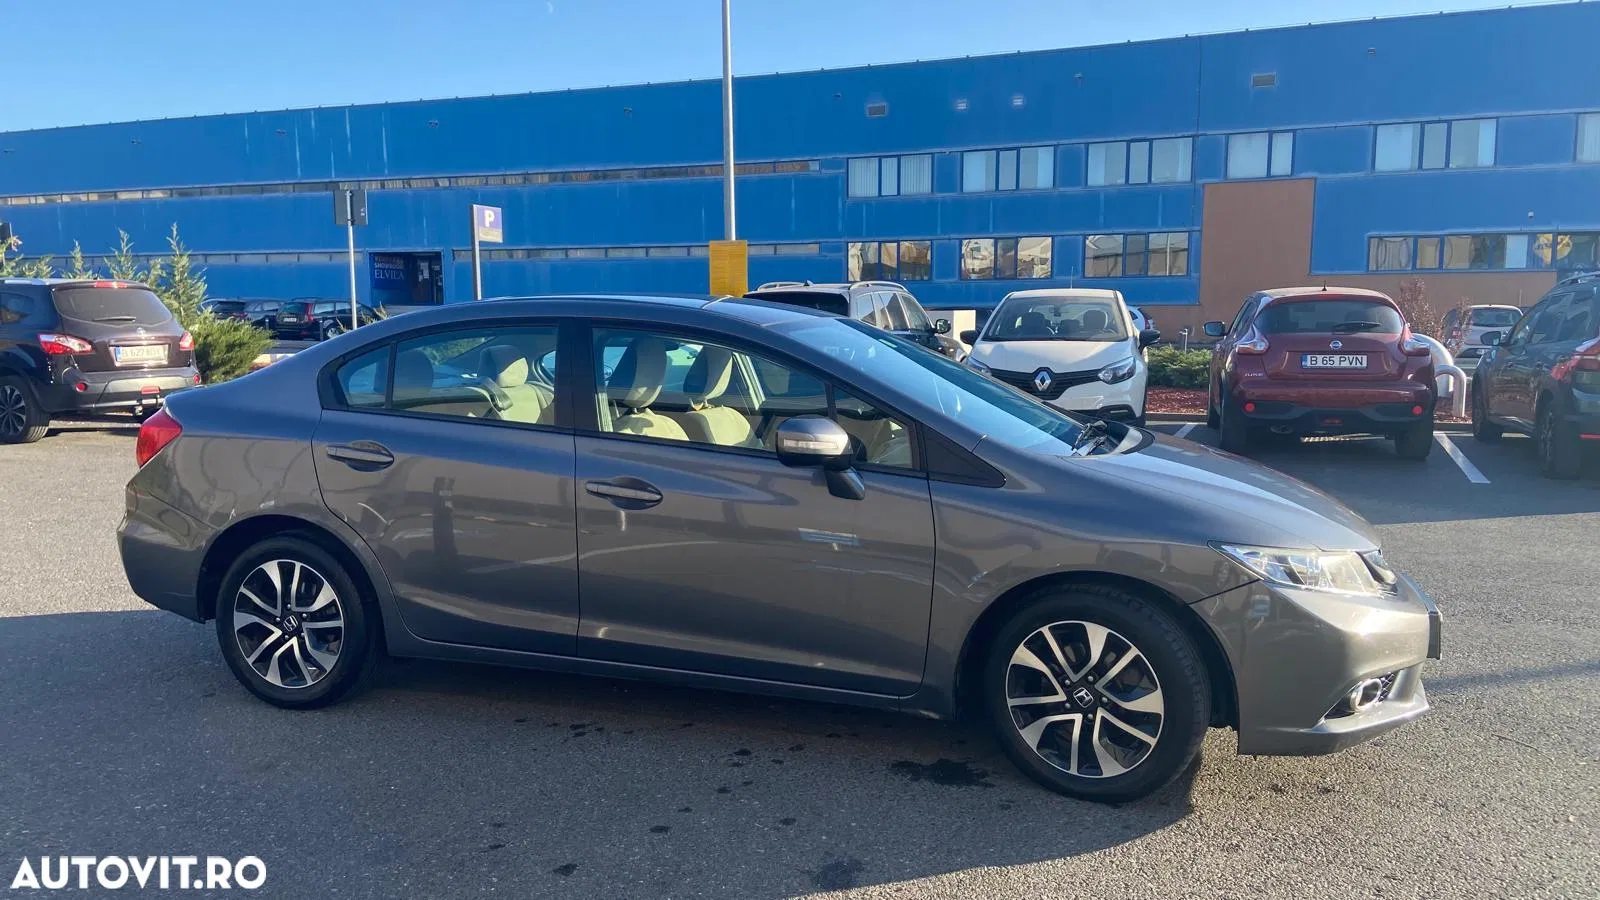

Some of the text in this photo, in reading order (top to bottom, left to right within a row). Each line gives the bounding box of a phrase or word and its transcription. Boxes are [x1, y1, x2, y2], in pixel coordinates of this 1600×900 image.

[484, 210, 495, 227] P
[1309, 356, 1363, 365] B 65 PVN
